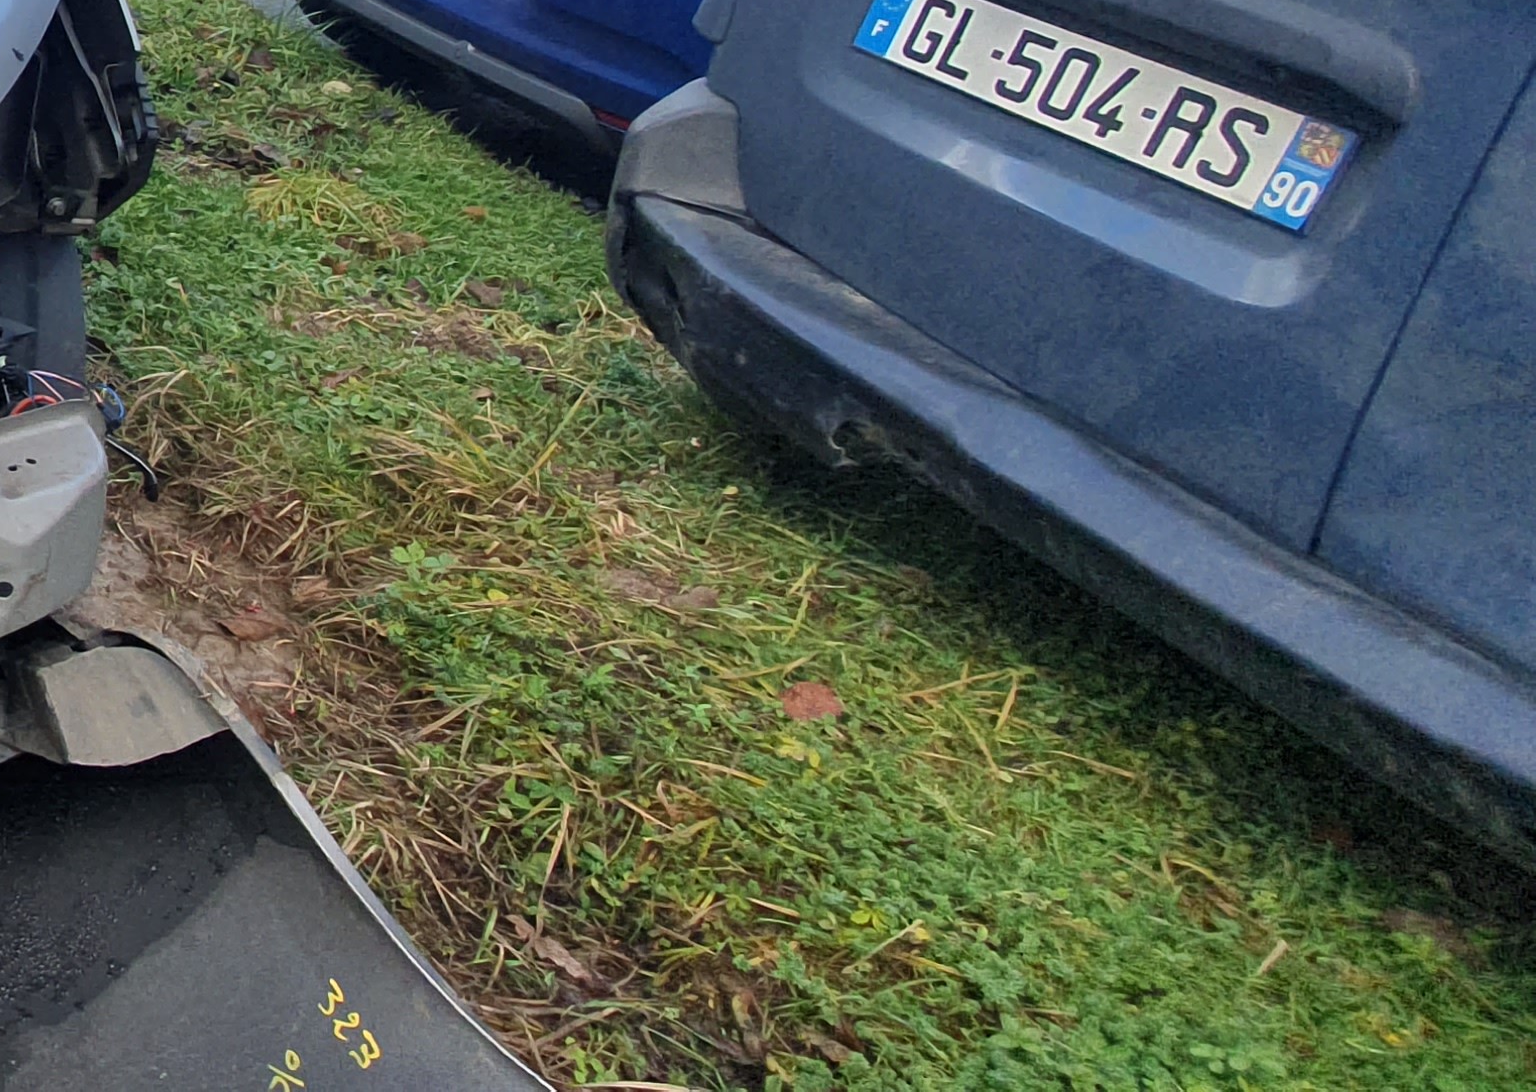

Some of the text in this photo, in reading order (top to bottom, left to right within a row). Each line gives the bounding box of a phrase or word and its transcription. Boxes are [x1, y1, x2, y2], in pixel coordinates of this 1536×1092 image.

[870, 19, 890, 37] F
[1262, 171, 1319, 218] 90
[317, 978, 381, 1070] 323
